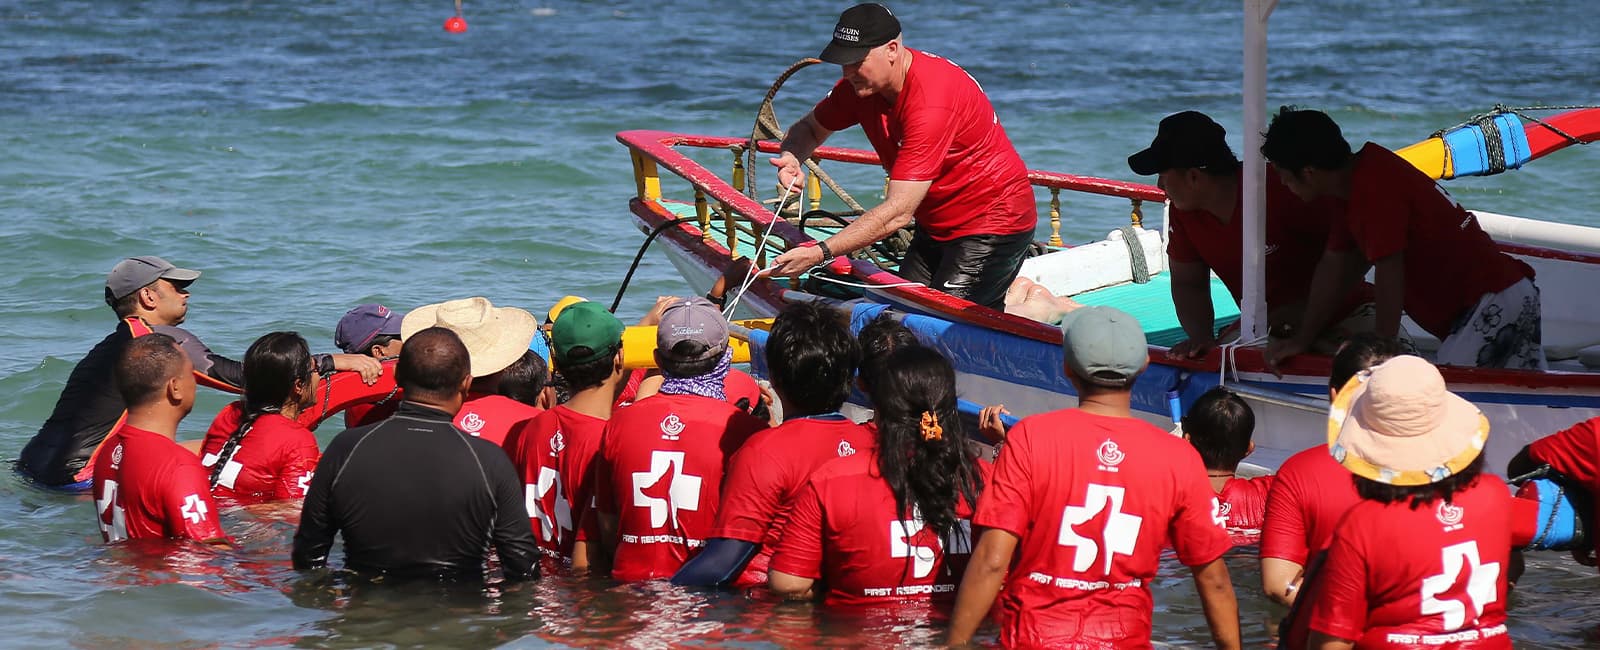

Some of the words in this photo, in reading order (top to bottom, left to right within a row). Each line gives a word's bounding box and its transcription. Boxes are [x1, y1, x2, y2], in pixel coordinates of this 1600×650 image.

[640, 534, 684, 545] RESPONDER
[1029, 572, 1053, 585] FIRST
[1055, 577, 1110, 591] RESPONDER
[863, 586, 893, 597] FIRST
[895, 583, 956, 596] RESPONDER
[1386, 633, 1420, 645] FIRST
[1422, 629, 1480, 645] RESPODER
